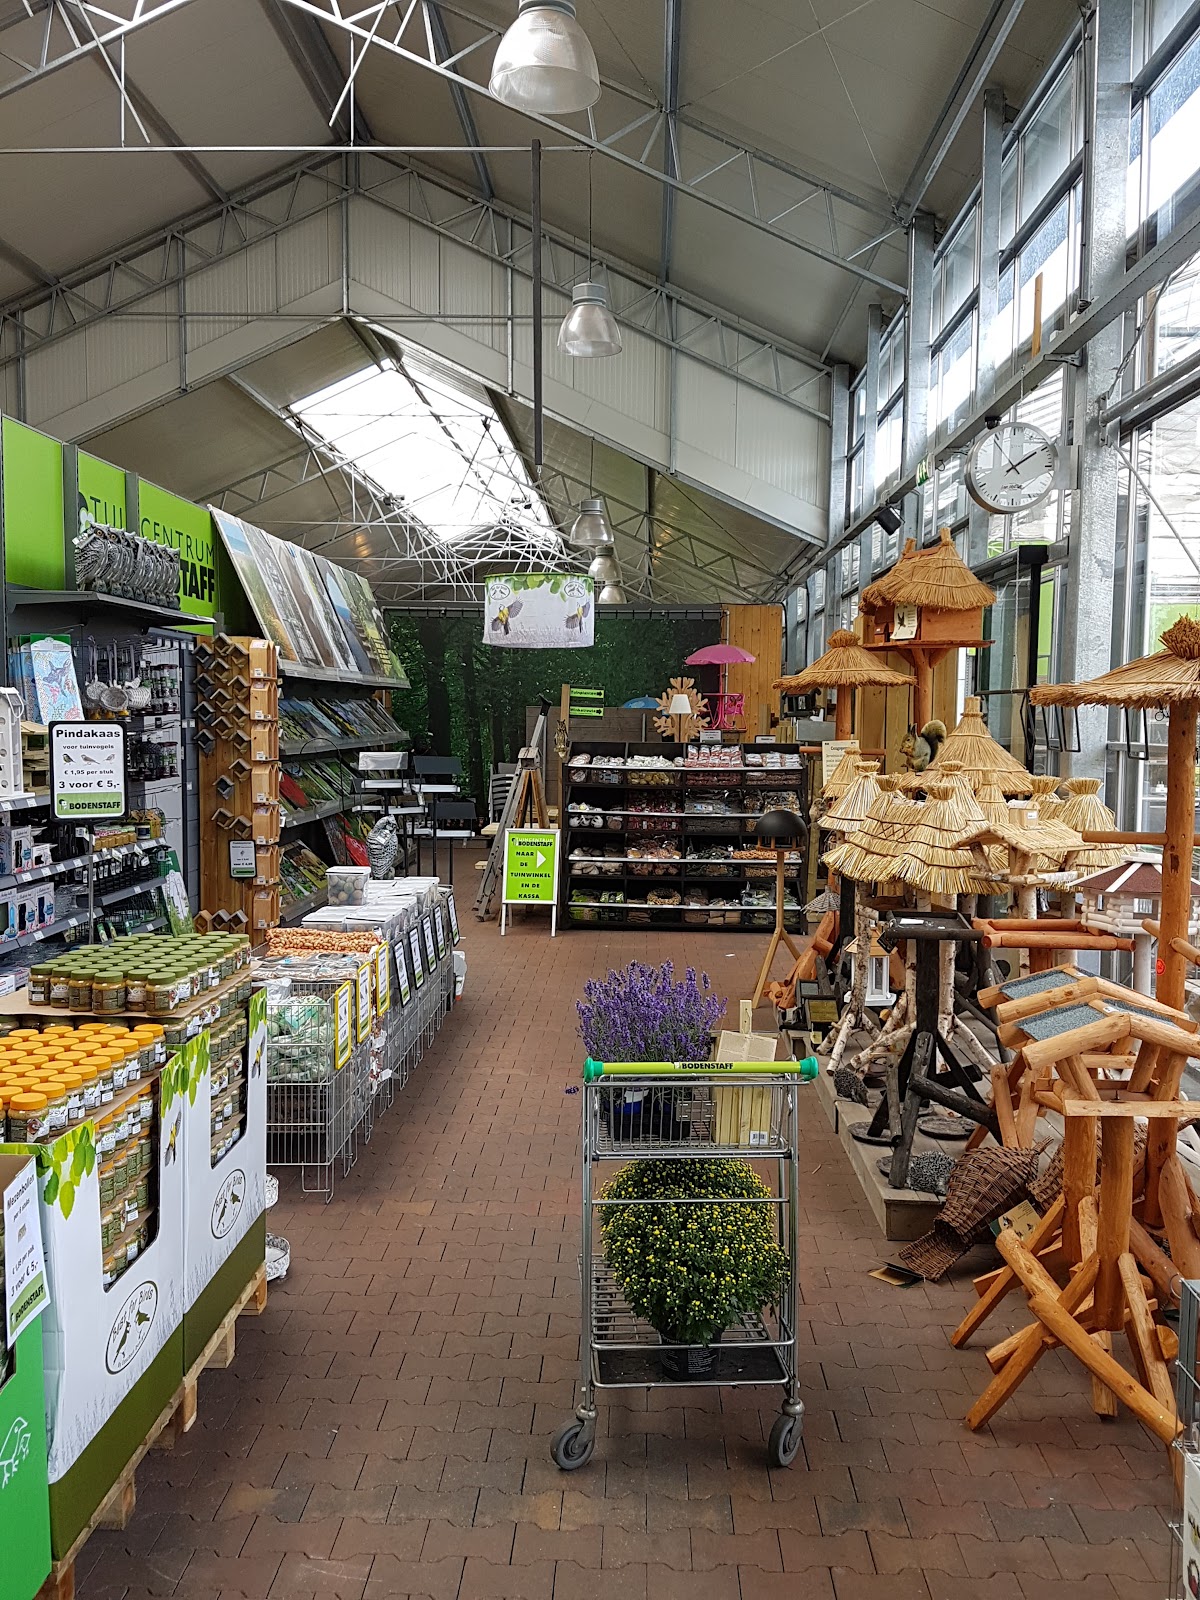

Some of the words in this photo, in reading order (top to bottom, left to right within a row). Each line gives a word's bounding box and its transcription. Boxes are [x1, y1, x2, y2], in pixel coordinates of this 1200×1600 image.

[141, 518, 215, 566] CENTRUM
[11, 1285, 15, 1297] 3
[15, 1284, 44, 1323] BODENSTAFF
